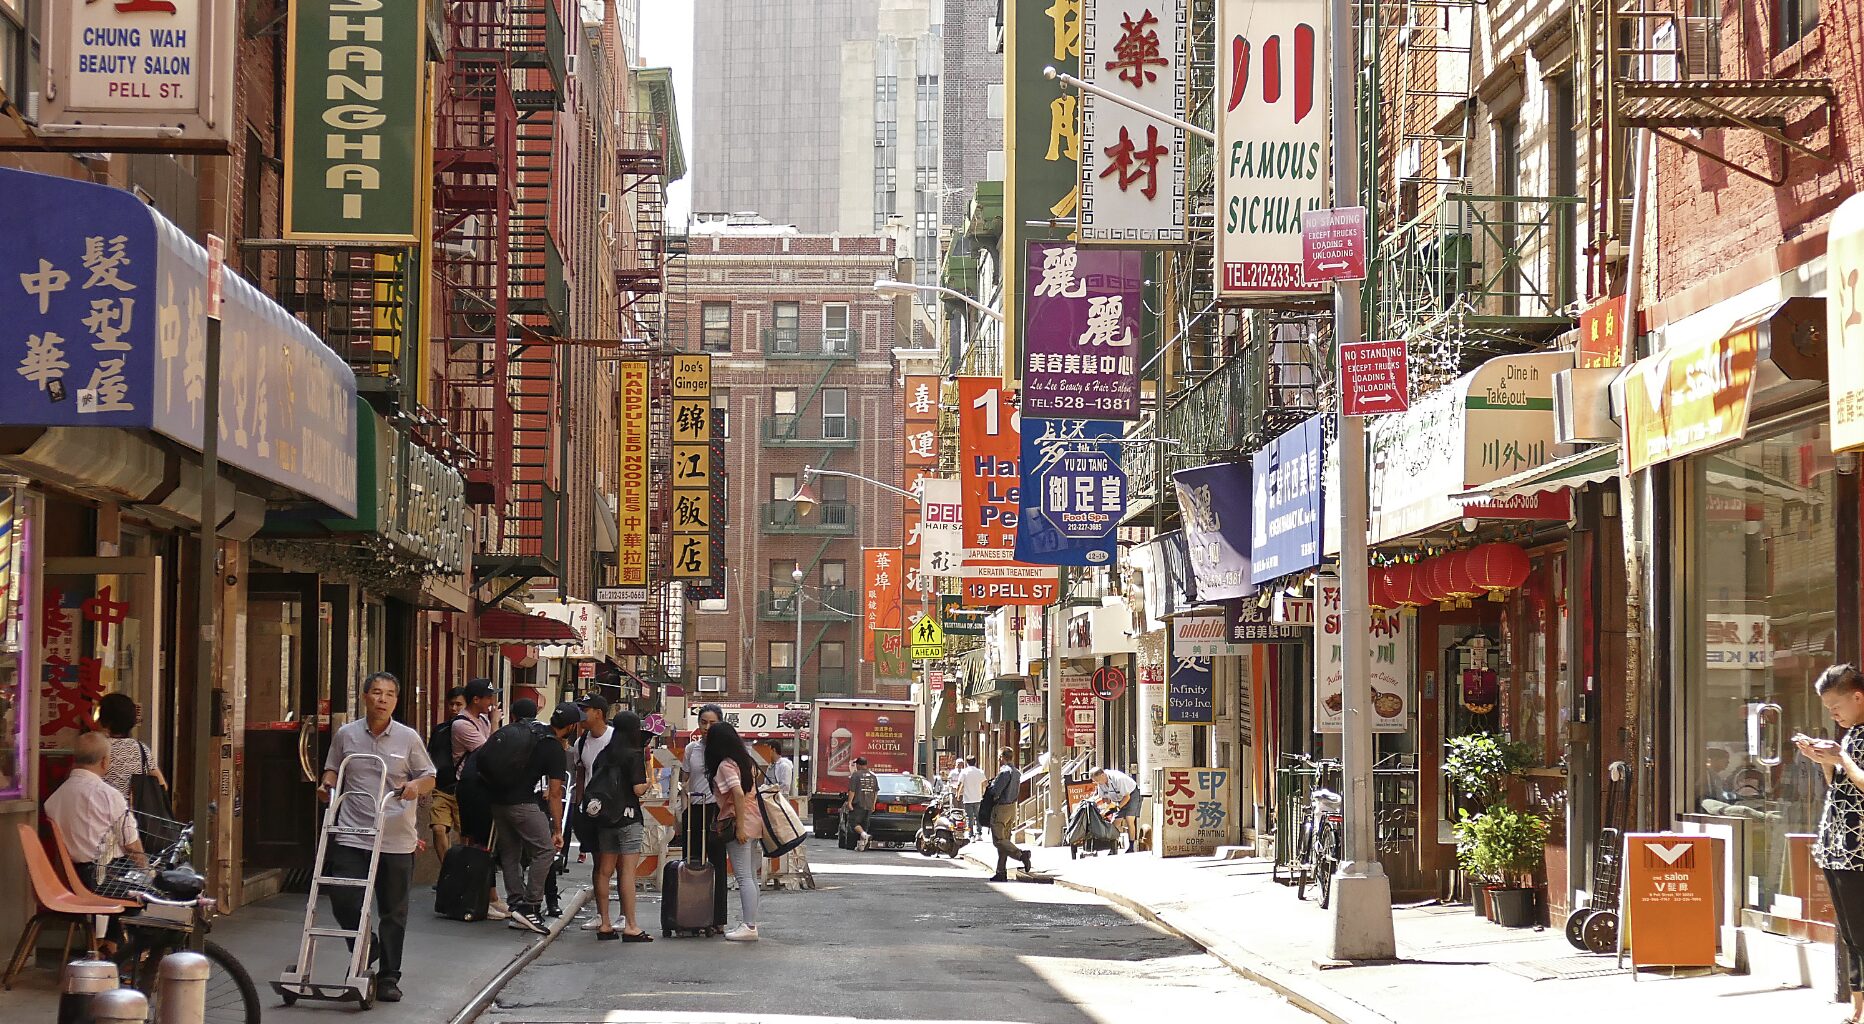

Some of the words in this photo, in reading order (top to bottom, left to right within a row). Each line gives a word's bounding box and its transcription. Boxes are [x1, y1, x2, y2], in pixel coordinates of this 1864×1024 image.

[83, 27, 141, 48] CHUNG
[150, 28, 187, 48] WAH
[79, 54, 137, 74] BEAUTY
[144, 55, 190, 75] SALON
[108, 82, 151, 98] PELL
[159, 83, 184, 98] ST.
[1099, 8, 1169, 200] 藥材
[1229, 140, 1320, 181] FAMOUS
[1306, 218, 1318, 228] NO
[1320, 214, 1360, 226] STANDING
[1308, 231, 1332, 240] EXCEPT
[1333, 228, 1357, 238] TRUCKS
[1312, 240, 1343, 250] LOADING
[1347, 239, 1353, 247] &
[1312, 249, 1354, 260] UNLOADING
[1226, 263, 1319, 288] TEL:212-233-3
[16, 258, 71, 391] 中華
[81, 235, 136, 411] 髮型屋
[1344, 350, 1357, 361] NO
[1360, 346, 1402, 359] STANDING
[679, 359, 703, 373] Joe's
[1029, 352, 1134, 375] 美容美髮中心
[1347, 363, 1372, 373] EXCEPT
[1374, 361, 1400, 370] TRUCKS
[1352, 373, 1385, 383] LOADING
[1389, 372, 1396, 380] &
[1507, 364, 1528, 381] Dine
[1530, 367, 1539, 381] in
[675, 376, 708, 391] Ginger
[1059, 379, 1083, 396] Beauty
[1093, 381, 1109, 393] Hair
[1111, 381, 1132, 394] Salon
[1353, 382, 1396, 393] UNLOADING
[1500, 377, 1507, 389] &
[624, 372, 643, 452] HANDPULLED
[1482, 438, 1545, 471] 川外川
[1064, 458, 1075, 472] YU
[1076, 458, 1087, 472] ZU
[1089, 458, 1108, 472] TANG
[624, 456, 642, 512] NOODLES
[675, 403, 708, 574] 錦江飯店
[1049, 475, 1121, 512] 御足堂
[1062, 513, 1087, 522] Foot
[1088, 512, 1109, 522] Spa
[925, 523, 948, 531] HAIR
[968, 549, 1001, 560] JAPANESE
[978, 567, 1006, 577] KERATIN
[1007, 566, 1043, 577] TREATMENT
[968, 583, 986, 599] 18
[989, 583, 1029, 598] PELL
[1033, 583, 1052, 598] ST
[914, 648, 940, 657] AHEAD
[1100, 668, 1119, 691] 18
[1378, 671, 1399, 687] Cuisine
[1170, 683, 1207, 696] Infinity
[1169, 698, 1193, 709] Style
[1195, 697, 1212, 708] Inc.
[1181, 711, 1199, 719] 12-14
[867, 743, 900, 751] MOUTAI
[1165, 771, 1196, 828] 天河
[1195, 771, 1227, 829] 印務
[1197, 829, 1225, 838] PRINTING
[1664, 871, 1689, 881] salon
[1654, 882, 1666, 892] V
